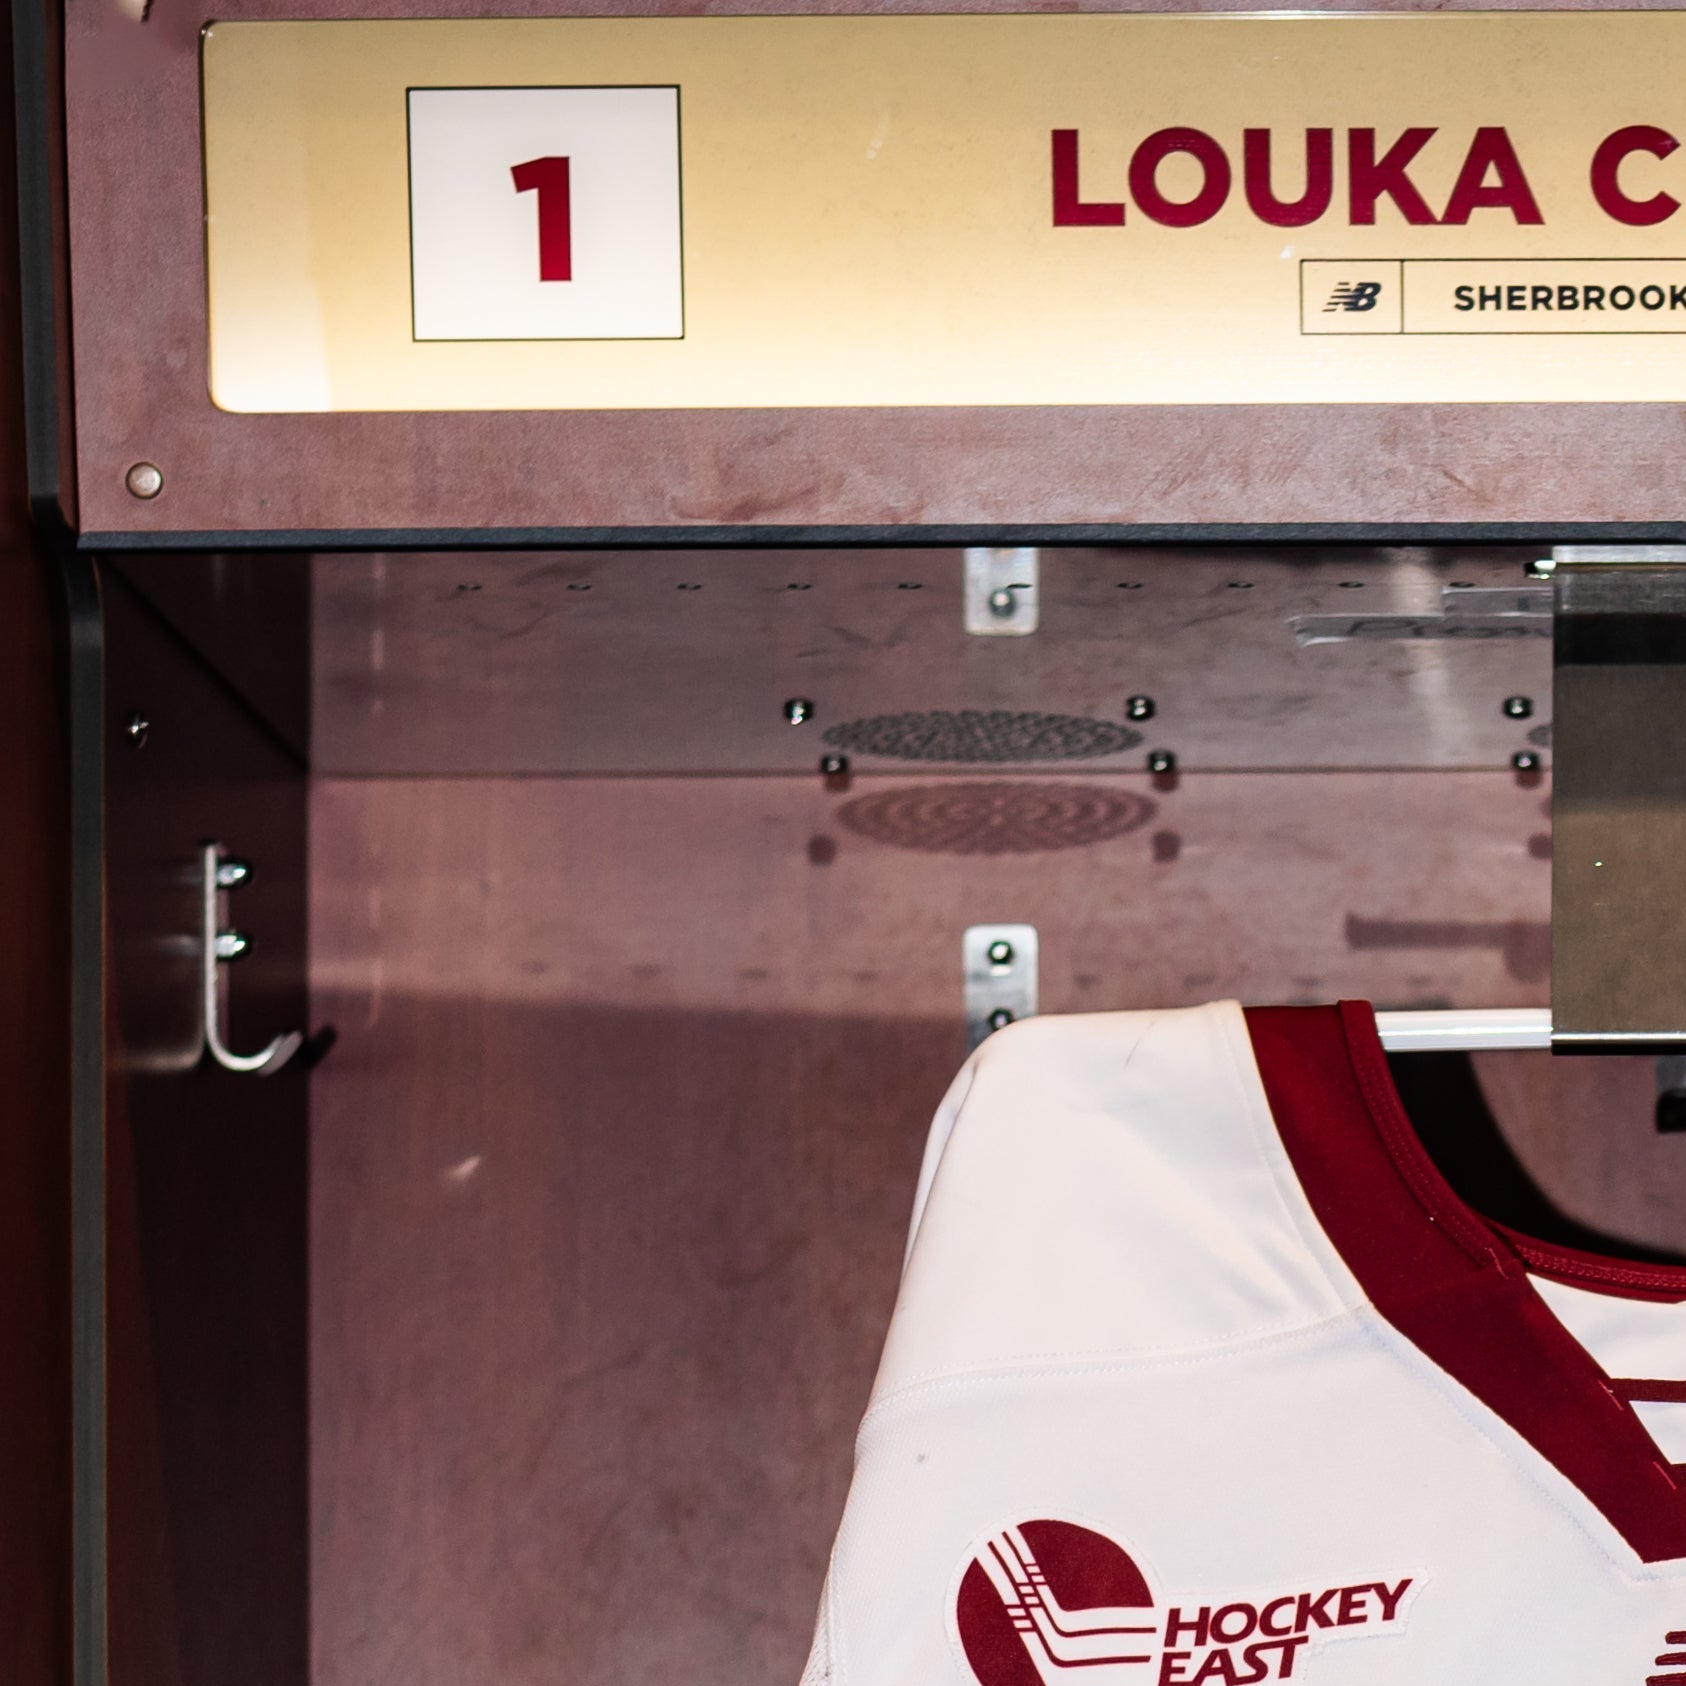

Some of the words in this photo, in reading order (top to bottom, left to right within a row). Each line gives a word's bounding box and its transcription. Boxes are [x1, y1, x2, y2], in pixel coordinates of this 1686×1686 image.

[510, 156, 573, 283] 1
[1052, 126, 1545, 229] LOUKA
[1163, 1578, 1414, 1648] HOCKEY
